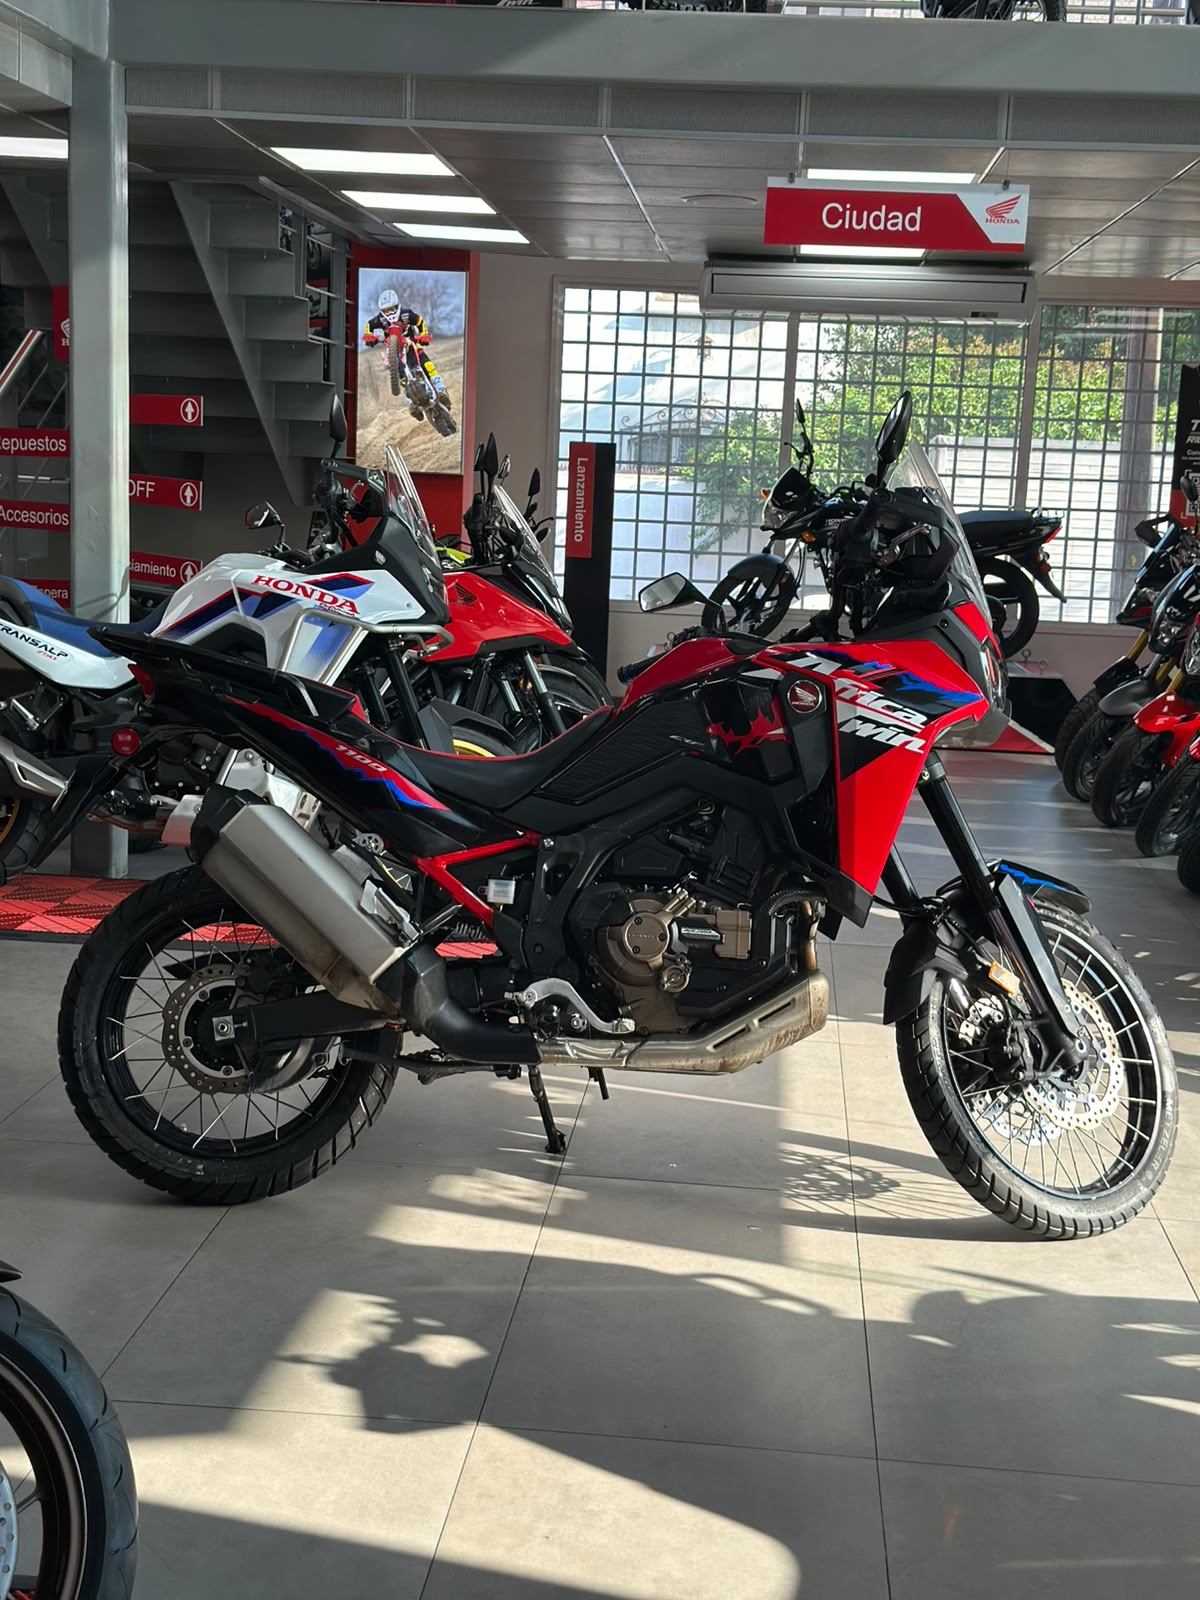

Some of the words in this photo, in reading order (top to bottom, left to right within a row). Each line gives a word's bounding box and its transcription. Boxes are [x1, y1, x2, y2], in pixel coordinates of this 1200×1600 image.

[821, 202, 922, 232] Ciudad
[0, 436, 67, 454] epuestos
[573, 457, 588, 543] Lanzamiento
[0, 504, 70, 526] Accesorios
[129, 559, 176, 578] iamiento
[33, 585, 69, 599] pera
[251, 575, 361, 615] HONDA
[336, 744, 388, 773] 1100
